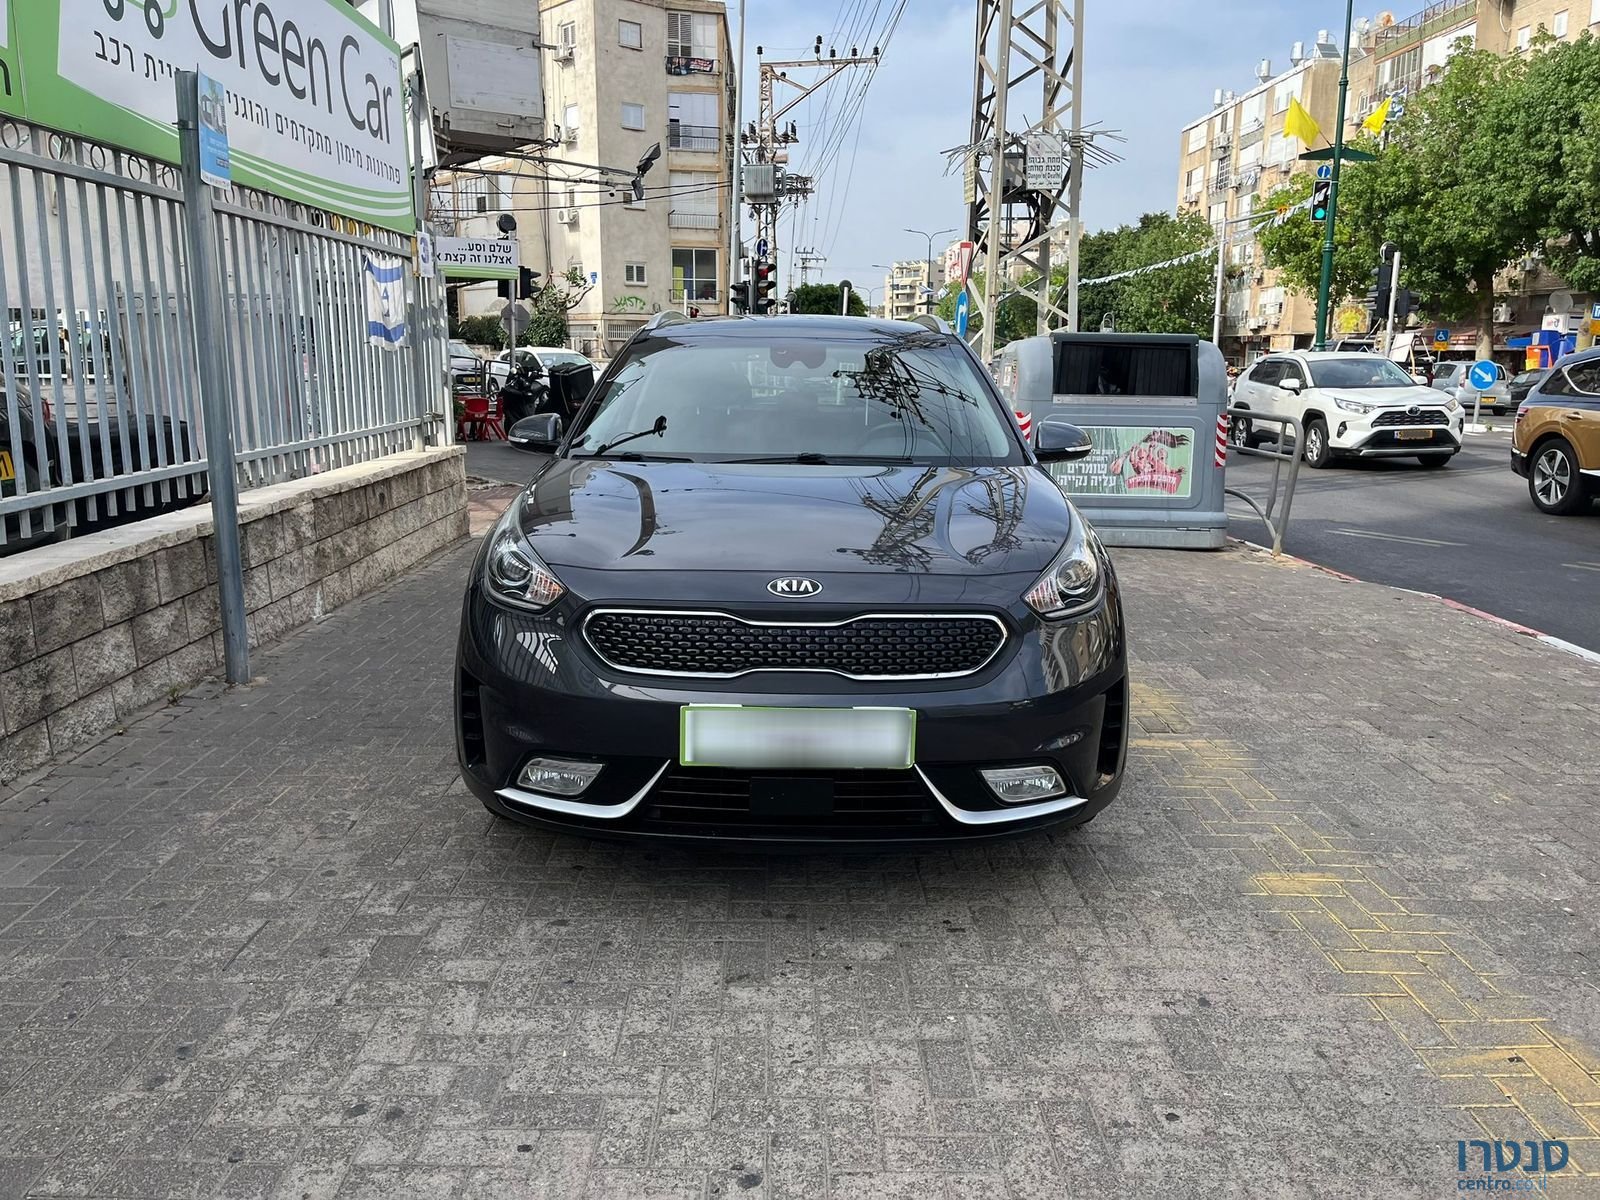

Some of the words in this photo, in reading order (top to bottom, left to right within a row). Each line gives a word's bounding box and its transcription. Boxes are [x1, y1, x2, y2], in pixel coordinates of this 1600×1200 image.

[93, 30, 135, 72] רכב
[339, 34, 392, 145] Car
[226, 89, 269, 128] והוגני
[275, 112, 332, 155] מתקדמים
[335, 140, 362, 168] מימון
[366, 154, 400, 184] פתרונות
[489, 243, 512, 254] שלם
[444, 252, 467, 264] קצת
[470, 254, 481, 263] זה
[484, 253, 512, 264] אצלנו
[1067, 463, 1107, 474] שומרים
[1090, 474, 1116, 487] עליה
[776, 579, 814, 592] KIA
